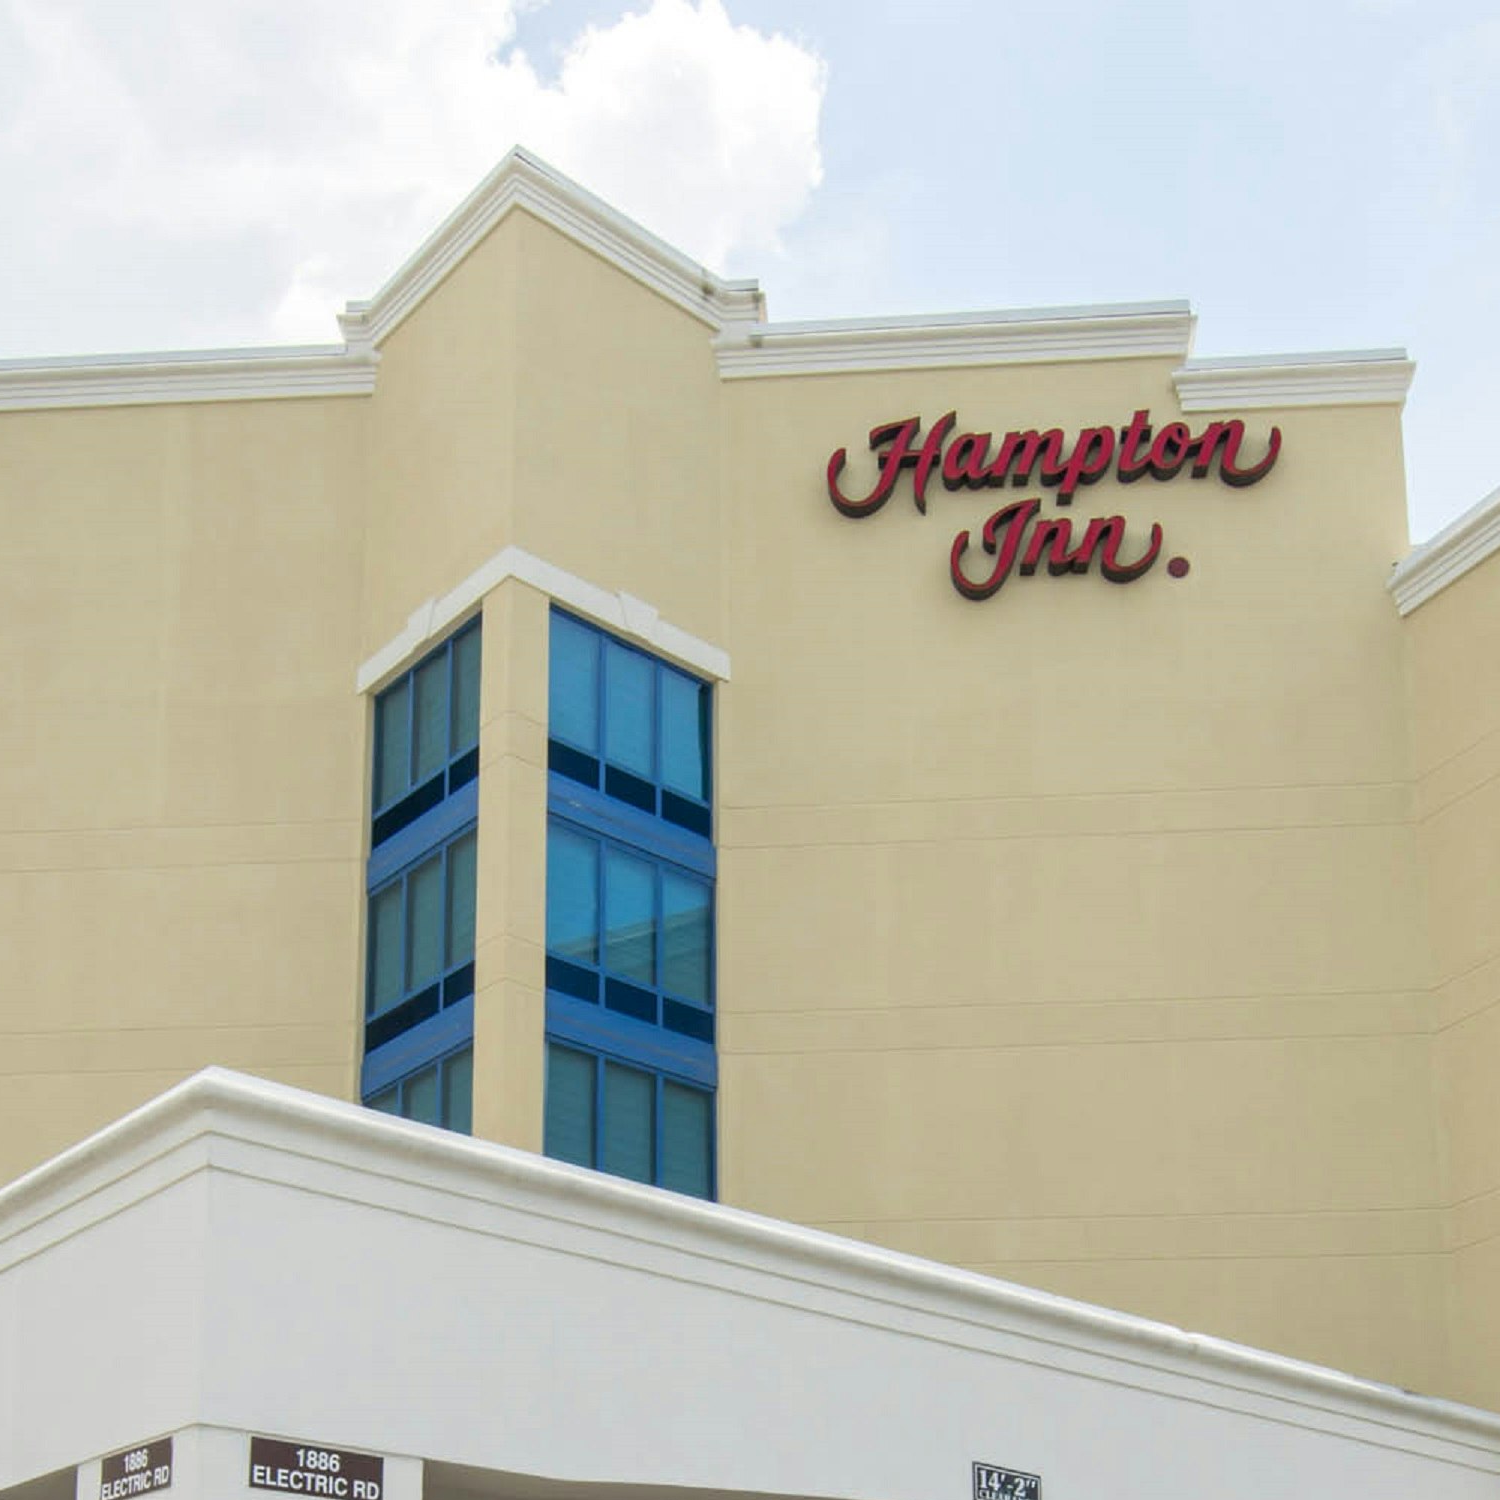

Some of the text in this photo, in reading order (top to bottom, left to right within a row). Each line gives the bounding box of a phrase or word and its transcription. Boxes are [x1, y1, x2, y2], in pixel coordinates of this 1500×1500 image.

[827, 410, 1282, 518] Hampton
[124, 1448, 148, 1473] 1886
[296, 1448, 341, 1472] 1886
[101, 1465, 169, 1500] ELECTRIC RD
[252, 1464, 379, 1500] ELECTRIC RD
